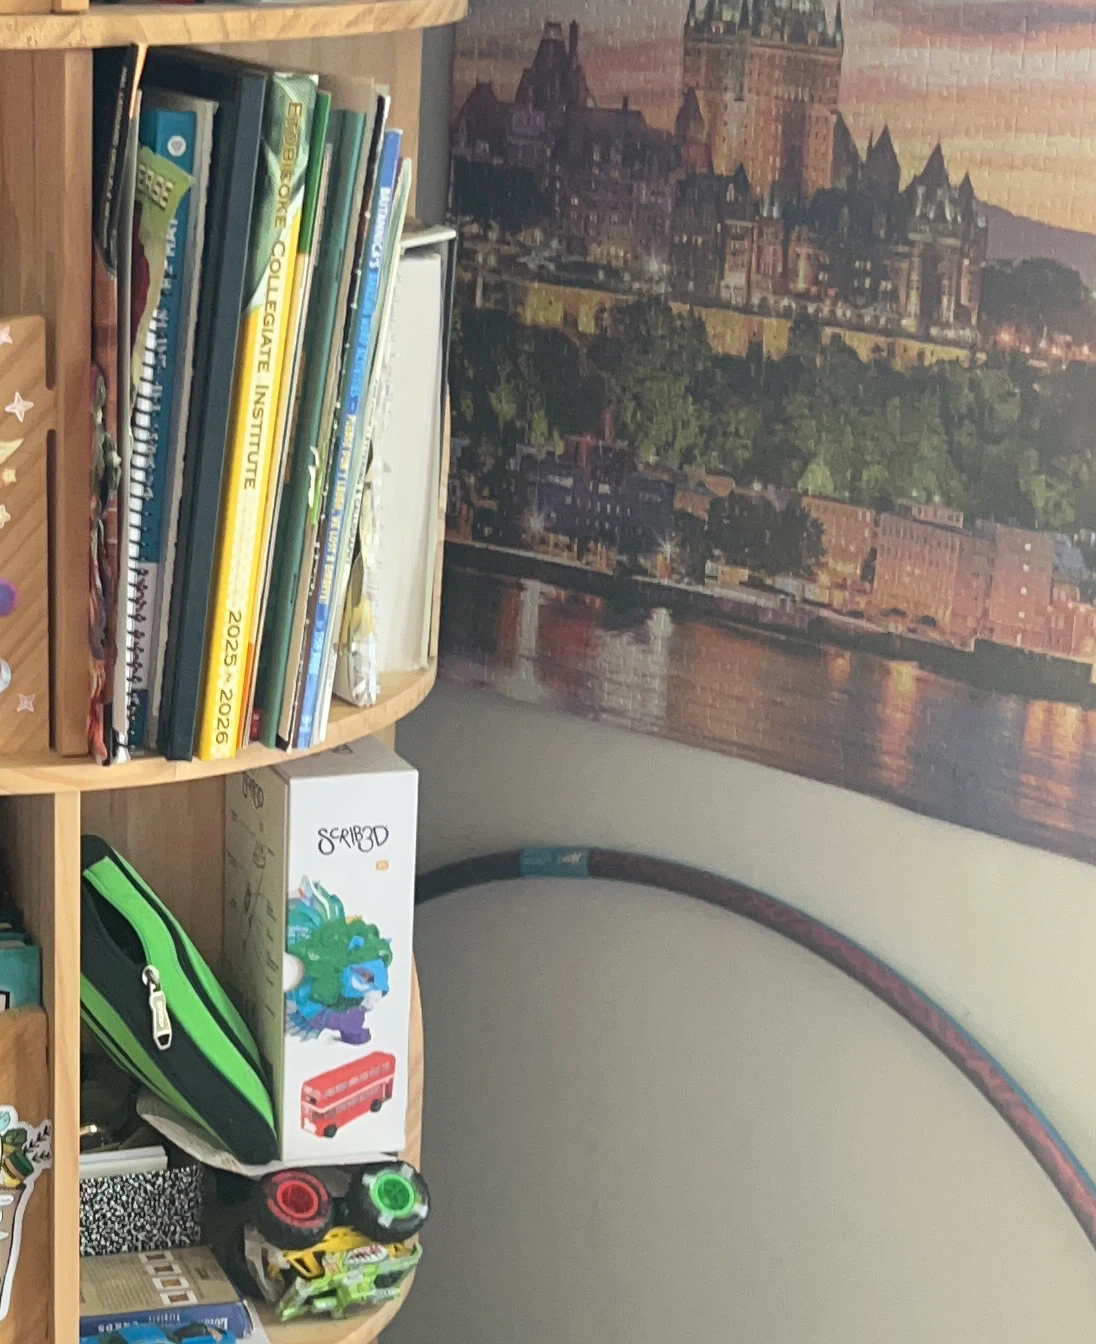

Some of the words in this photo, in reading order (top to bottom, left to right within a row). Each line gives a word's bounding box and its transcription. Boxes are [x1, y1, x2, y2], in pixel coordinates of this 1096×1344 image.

[275, 101, 303, 229] ETOBICOKE
[254, 240, 286, 374] COLLEGIATE
[243, 383, 271, 490] INSTITUTE
[223, 608, 244, 667] 2025
[215, 687, 235, 745] 2026
[318, 825, 389, 855] SCRIB3D
